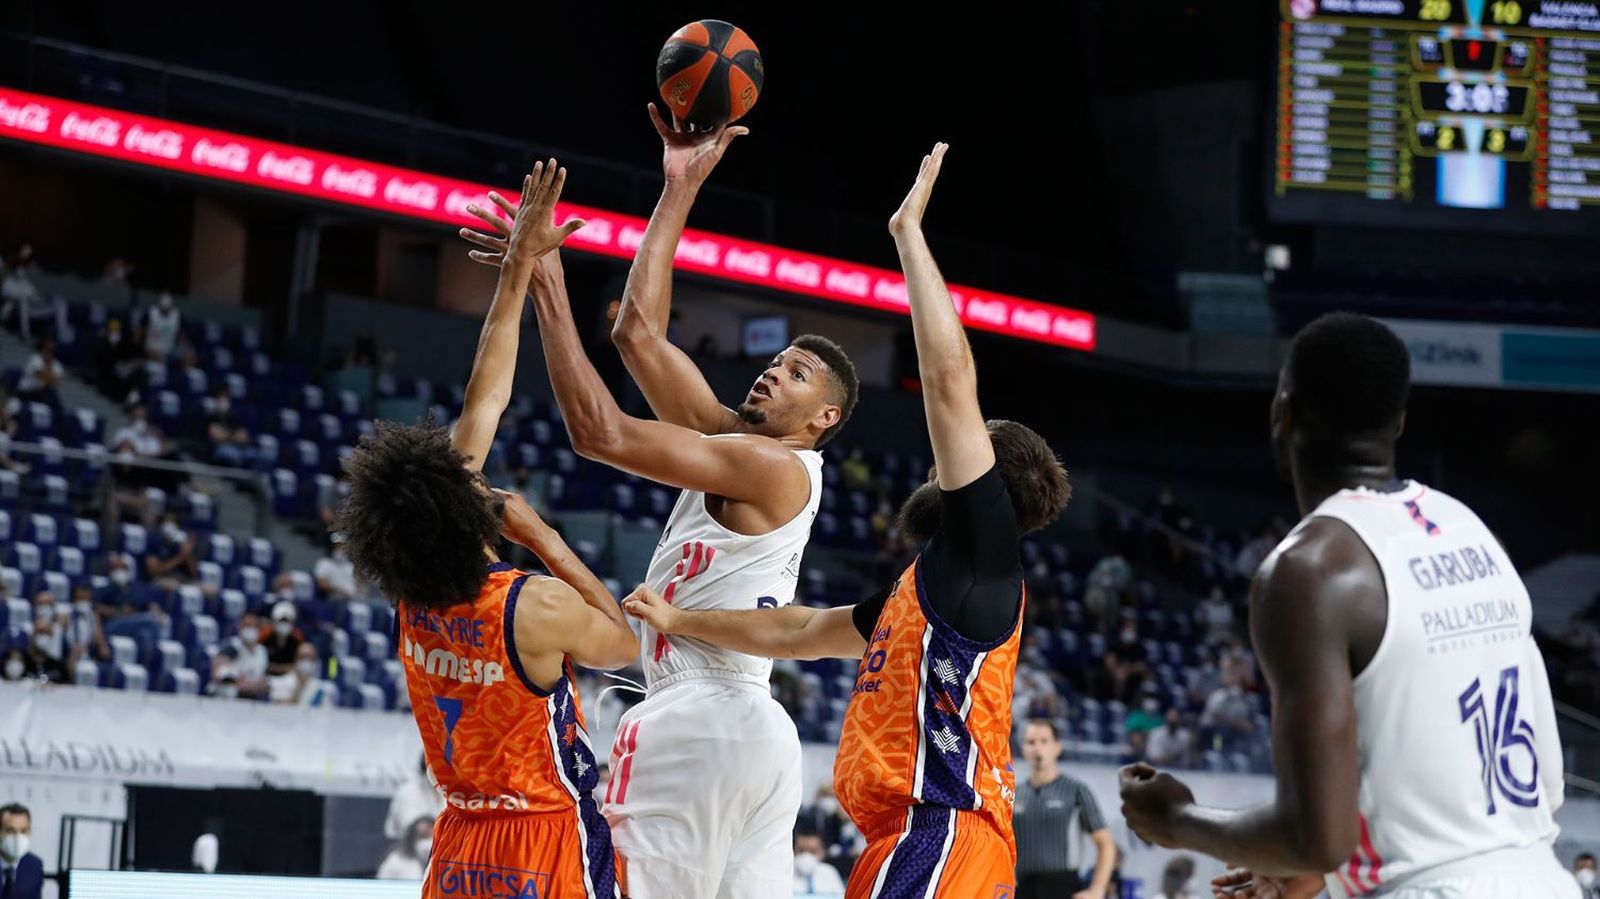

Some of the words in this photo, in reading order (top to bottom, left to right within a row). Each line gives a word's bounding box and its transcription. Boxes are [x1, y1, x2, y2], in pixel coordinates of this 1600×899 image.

[1408, 544, 1502, 590] GARUBA
[1421, 599, 1520, 635] PALLADIUM
[433, 695, 464, 769] 7
[1458, 665, 1540, 817] 16
[440, 866, 540, 899] GITICSA
